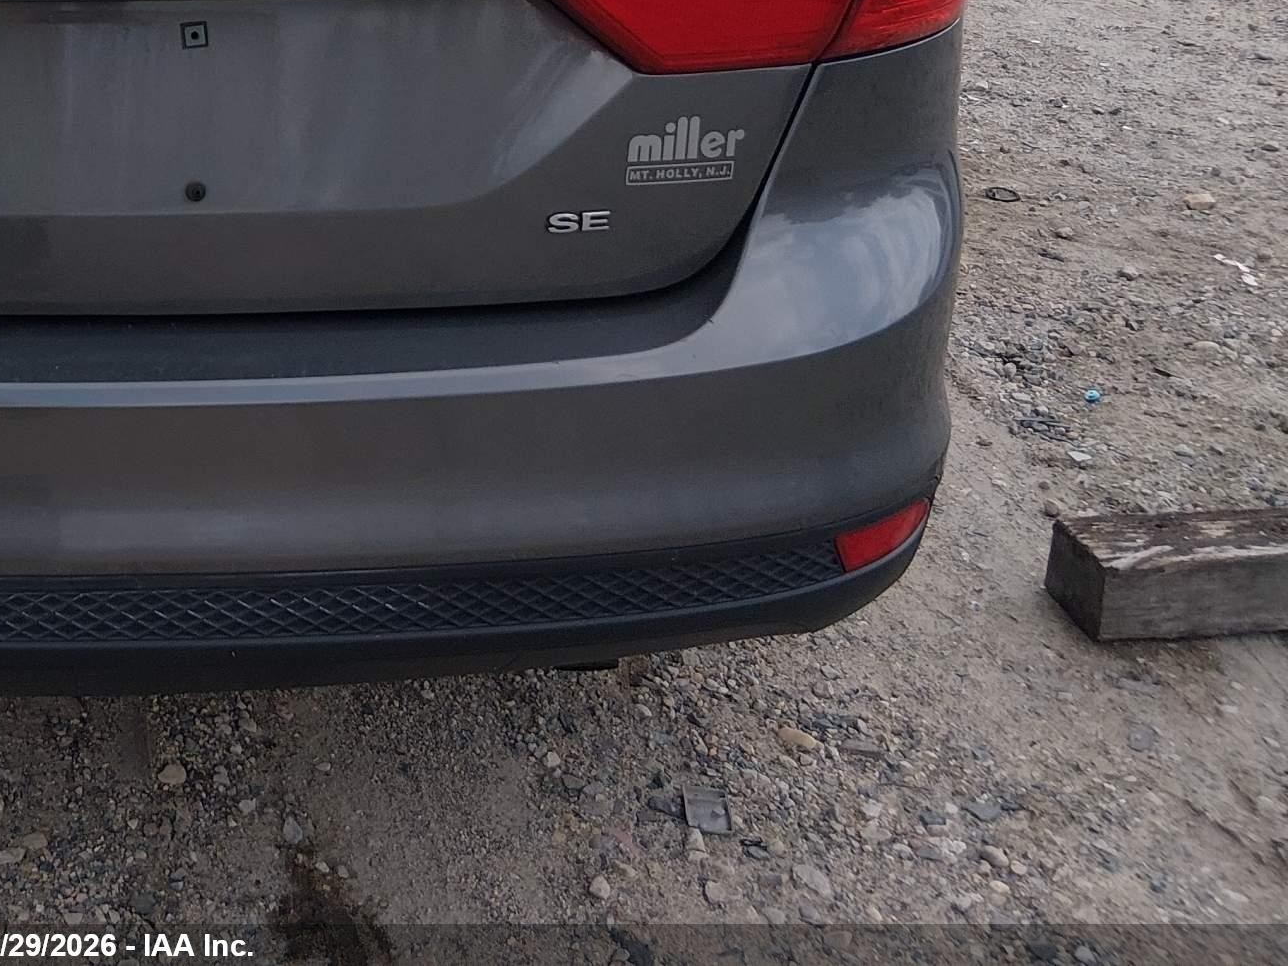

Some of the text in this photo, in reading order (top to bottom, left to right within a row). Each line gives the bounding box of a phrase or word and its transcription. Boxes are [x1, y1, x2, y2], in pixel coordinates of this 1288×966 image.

[627, 116, 745, 162] miller
[629, 165, 731, 180] MT. HOLLY, N.J.
[547, 210, 611, 233] SE
